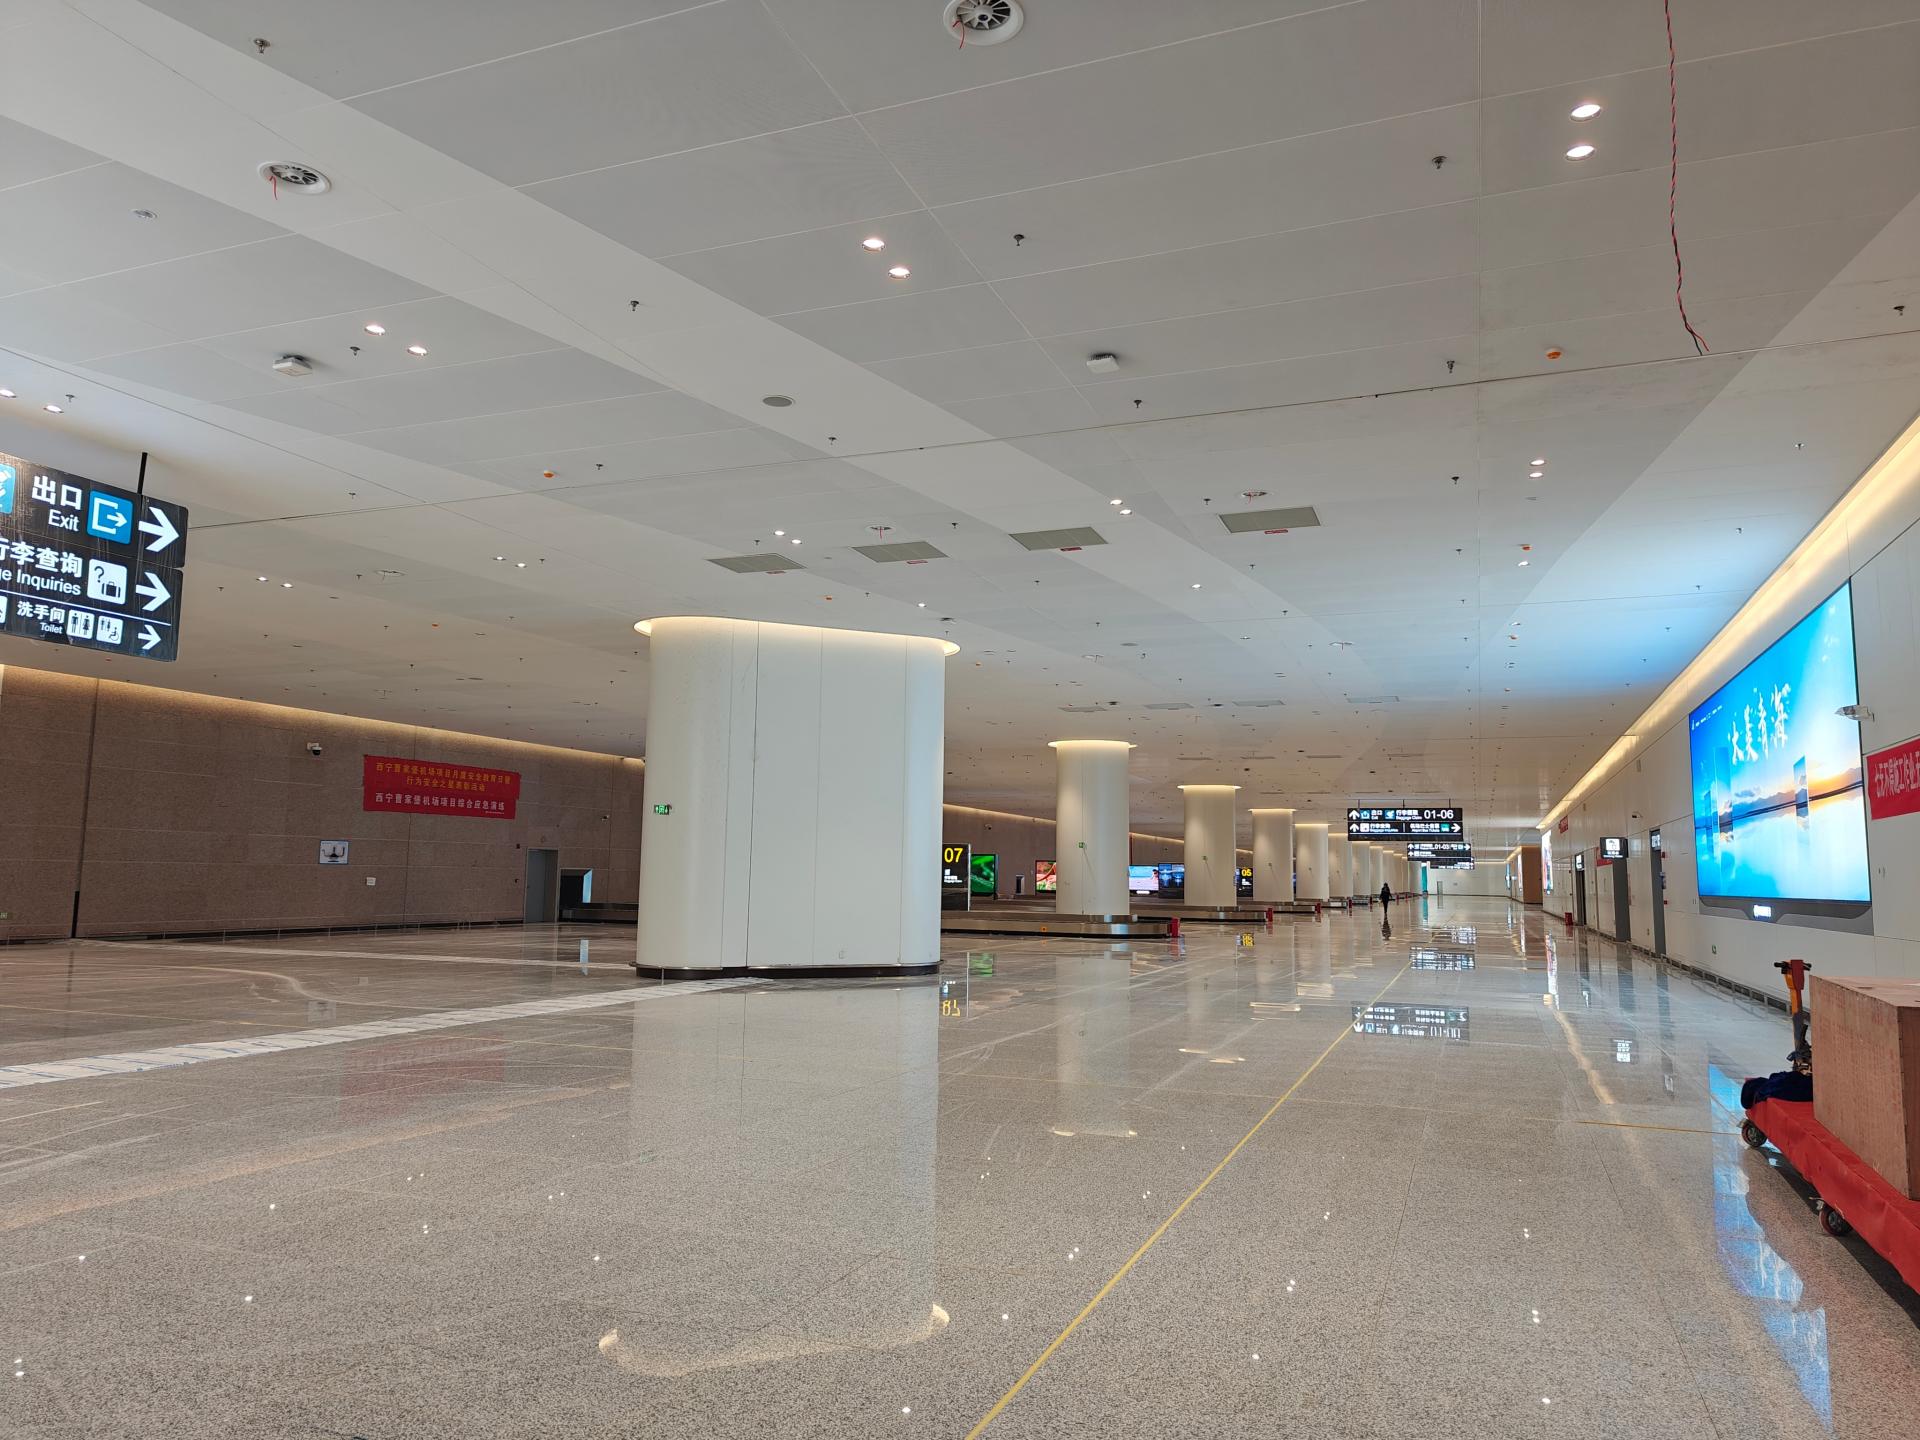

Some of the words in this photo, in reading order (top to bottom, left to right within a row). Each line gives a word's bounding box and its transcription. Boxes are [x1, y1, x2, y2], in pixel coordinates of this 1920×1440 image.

[32, 475, 82, 510] 出口
[48, 510, 80, 532] Exit
[17, 569, 81, 596] Inquiries
[17, 600, 65, 624] 洗手间
[40, 623, 63, 634] Toilet
[1424, 809, 1454, 819] 01-06
[944, 847, 963, 863] 07
